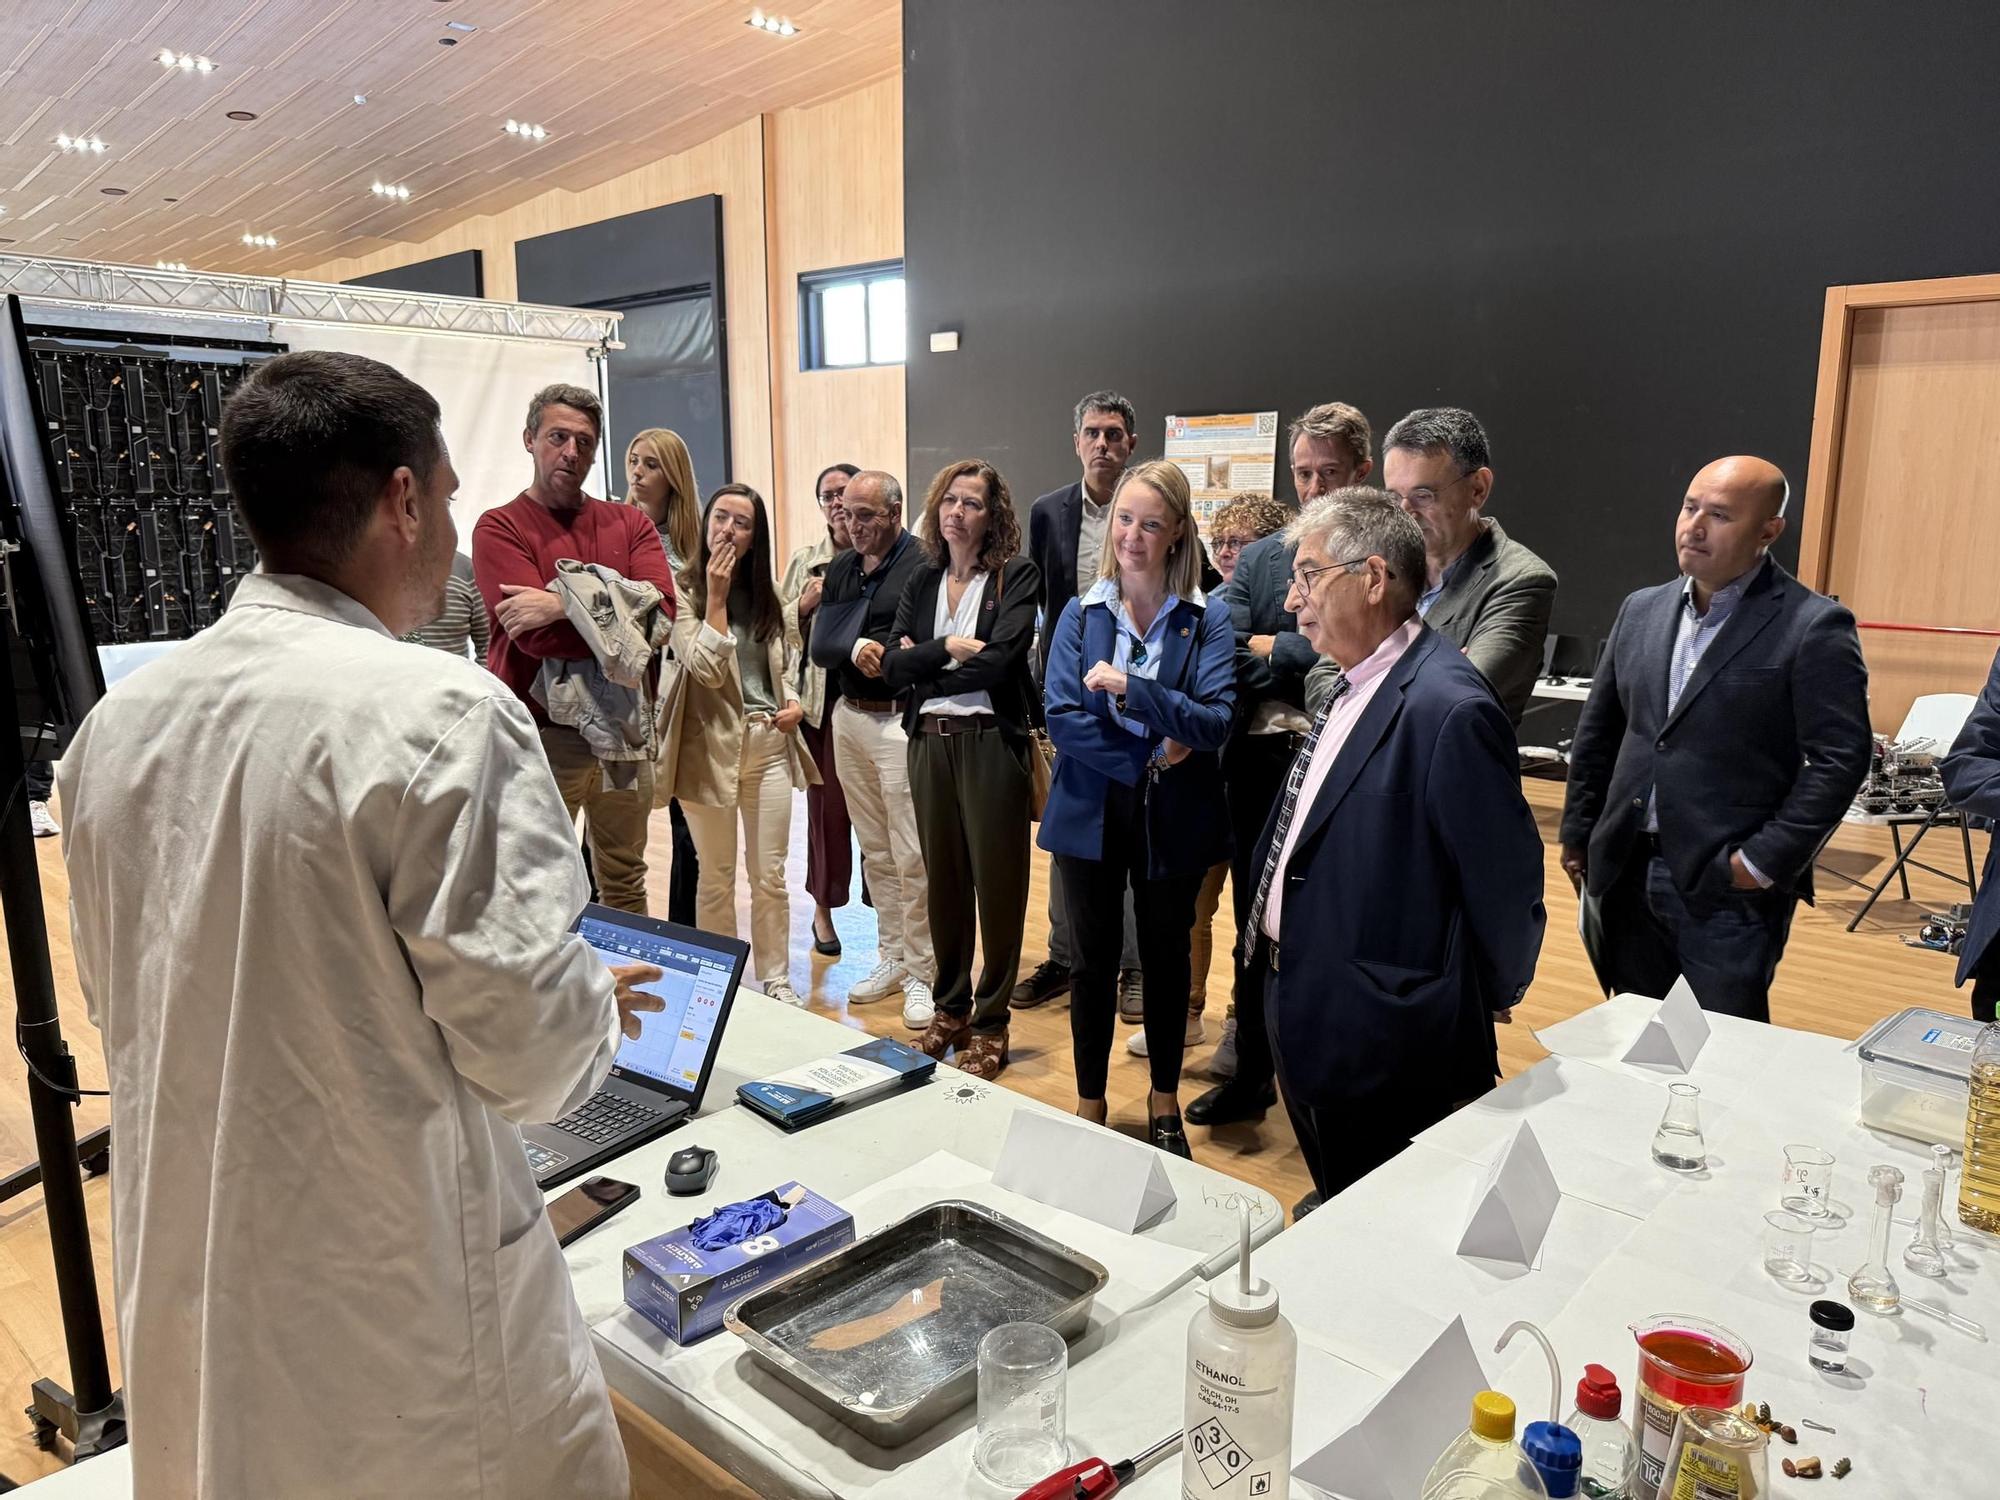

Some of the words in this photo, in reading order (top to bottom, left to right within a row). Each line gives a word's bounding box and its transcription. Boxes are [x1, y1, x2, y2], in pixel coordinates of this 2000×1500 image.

[1195, 1359, 1246, 1387] ETHANOL
[1194, 1434, 1204, 1454] 0
[1208, 1425, 1221, 1445] 3
[1226, 1449, 1240, 1468] 0
